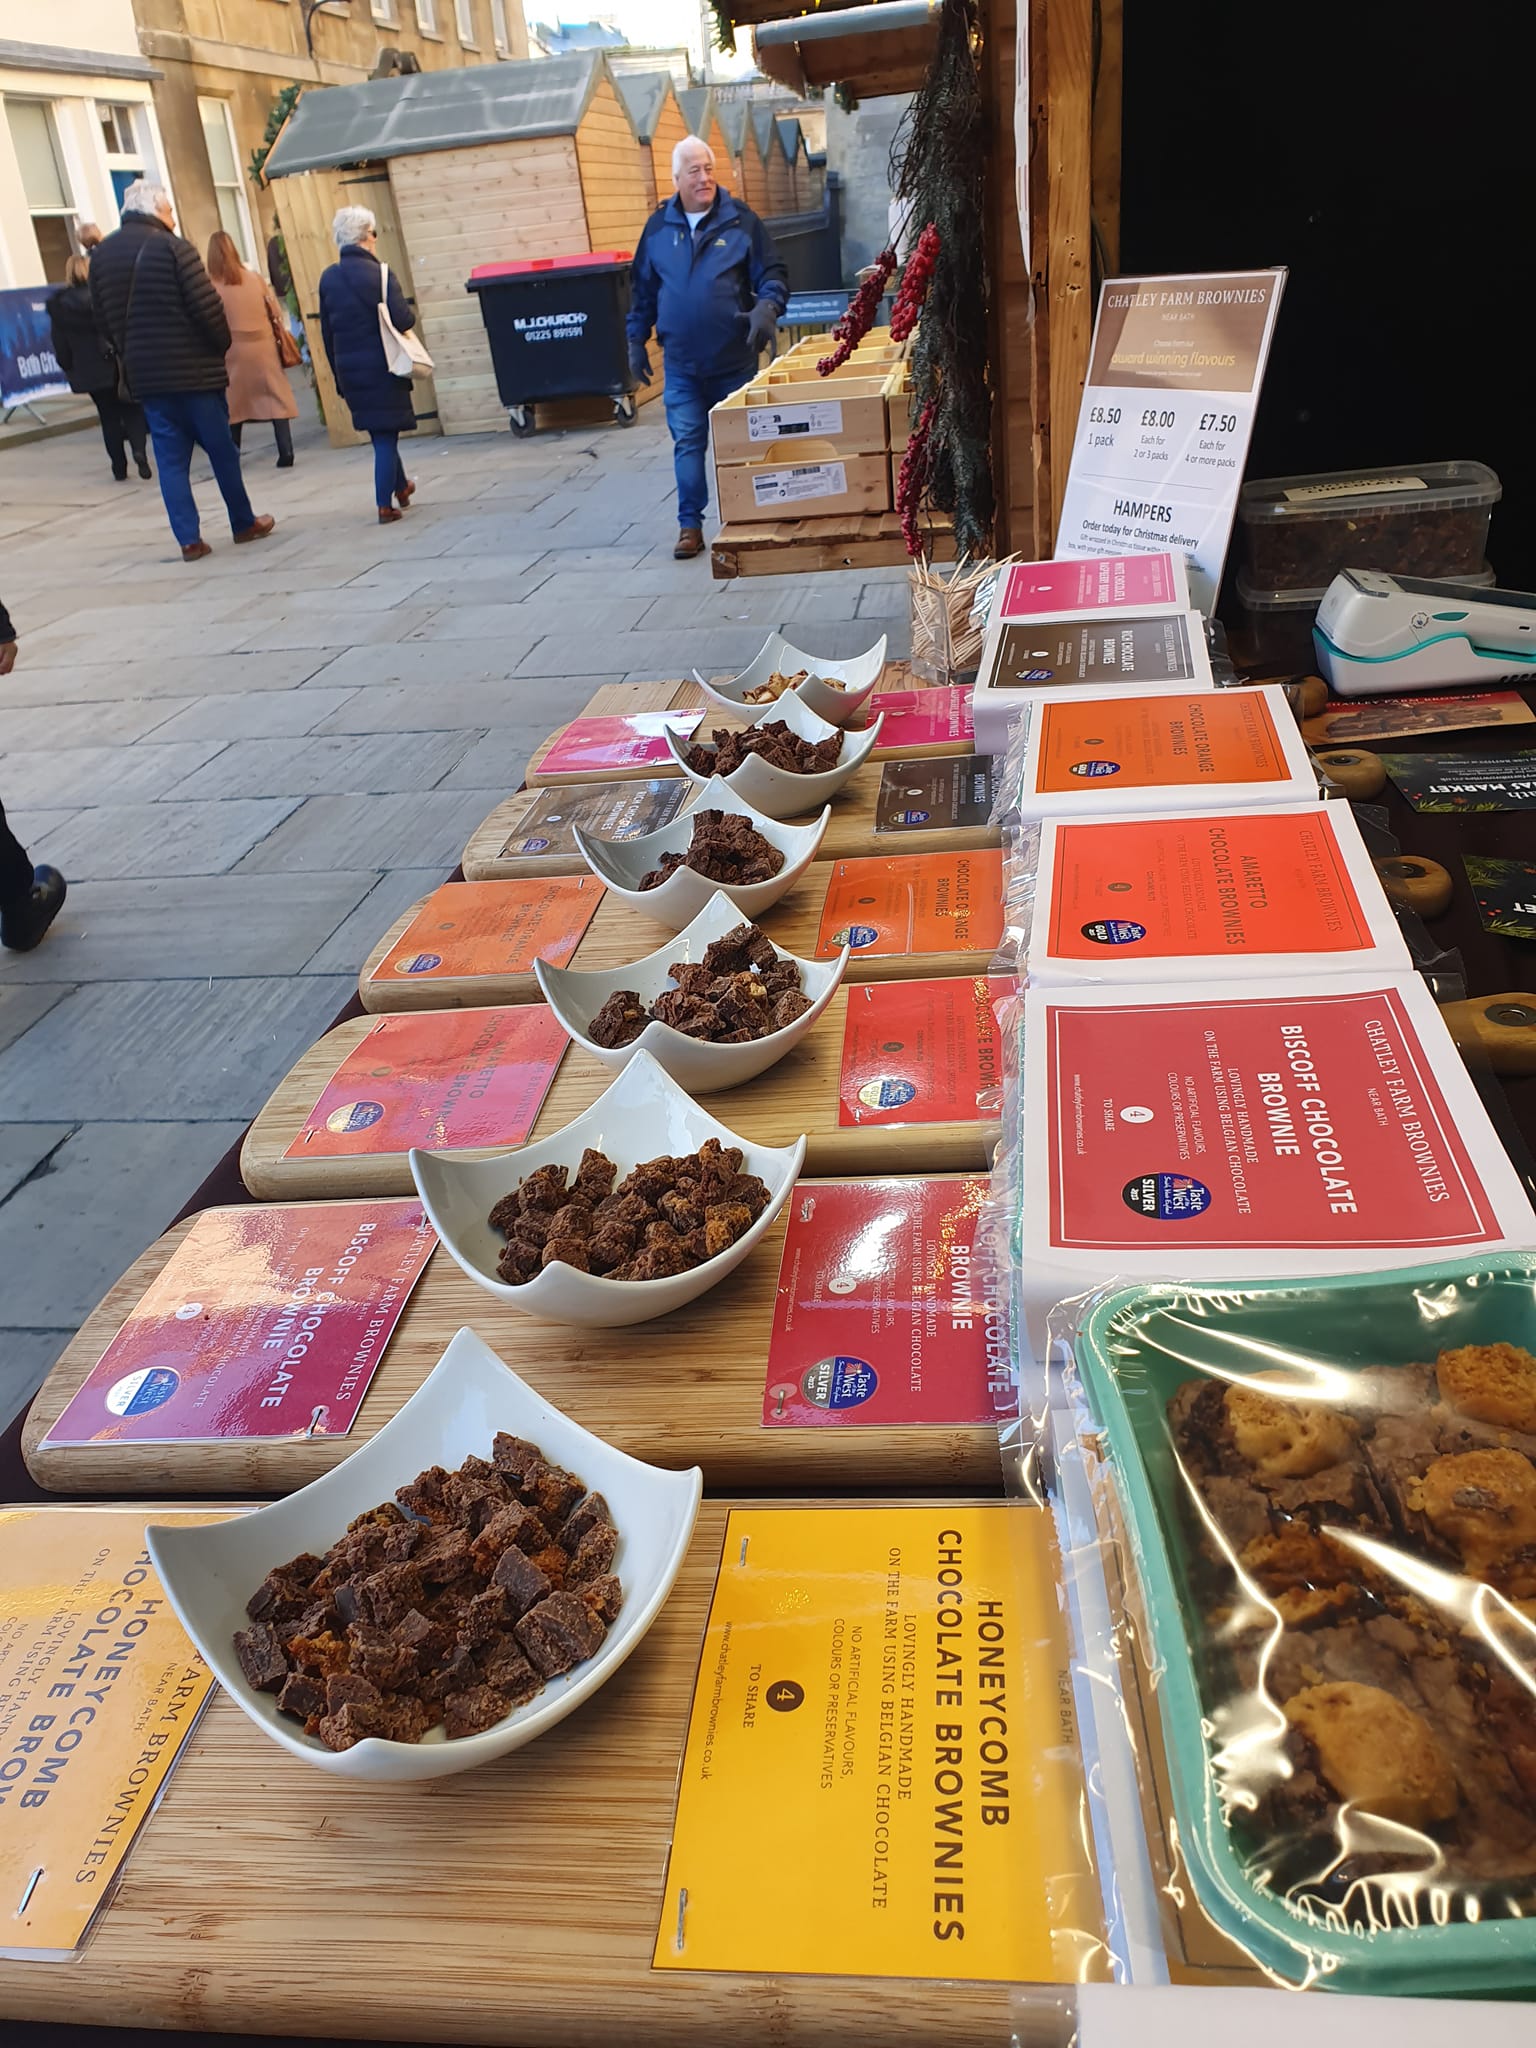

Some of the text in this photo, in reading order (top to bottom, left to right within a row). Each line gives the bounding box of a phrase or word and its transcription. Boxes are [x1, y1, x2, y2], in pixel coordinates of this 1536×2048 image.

[1107, 288, 1266, 309] CHATLEY FARM BROWNIES
[1111, 351, 1236, 368] award winning flavours
[1089, 407, 1122, 424] £8.50
[1141, 410, 1175, 428] £8.00
[1199, 413, 1237, 433] £7.50
[1088, 433, 1115, 447] 1 pack
[1141, 435, 1166, 446] Each for
[1199, 440, 1226, 451] Each for
[1113, 499, 1172, 523] HAMPERS
[1082, 519, 1199, 550] Order today for Christmas delivery
[1103, 638, 1116, 664] BROWNIES
[1121, 630, 1135, 672] RICH CHOCOLATE
[1168, 721, 1188, 755] BROWNIES
[1187, 703, 1215, 772] CHOCOLATE ORANGE
[974, 773, 986, 803] BROWNIES
[1429, 784, 1507, 793] MARKET
[935, 878, 951, 917] BROWNIES
[956, 859, 971, 901] CHOCOLATE
[1209, 827, 1245, 944] CHOCOLATE BROWNIES
[1240, 855, 1268, 909] AMARETTO
[1299, 830, 1344, 931] CHATLEY FARM BROWNIES
[500, 903, 534, 942] BROWNIES
[527, 885, 562, 927] CHOCOLATE
[506, 928, 536, 964] ORANGE
[1095, 924, 1108, 940] GOLD
[976, 985, 993, 1043] OCOLATE
[426, 1014, 506, 1139] CHOCOLATE BROWNS
[467, 1040, 506, 1099] AMARETTO
[1103, 1099, 1115, 1131] TO SHARE
[1167, 1072, 1190, 1160] COLOURS OR PRESERVATIVES
[1184, 1076, 1206, 1155] NO ARTIFICIAL FLAVOURS,
[1203, 1030, 1251, 1214] ON THE FARM USING BELGIAN CHOCOLATE
[1227, 1067, 1259, 1164] LOVINGLY HANDMADE
[1257, 1072, 1300, 1156] BROWNIE
[1280, 1025, 1358, 1214] BISCOFF CHOCOLATE
[1364, 1019, 1450, 1204] CHATLEY FARM BROWNIES
[1366, 1087, 1390, 1128] NEAR BATH
[1142, 1178, 1156, 1211] SILVER
[1173, 1187, 1187, 1210] West
[1190, 1187, 1205, 1211] Taste
[328, 1223, 377, 1285] BISCOFF
[913, 1233, 922, 1255] FARM
[912, 1256, 922, 1282] USING
[926, 1239, 937, 1338] LOVINGLY HANDMADE
[951, 1244, 973, 1330] BROWNIE
[262, 1268, 325, 1350] BROWNIE
[336, 1223, 434, 1400] CHATLEY FARM BROWNIES
[885, 1292, 897, 1328] FLAVOURS,
[911, 1285, 922, 1325] BELGIAN
[260, 1291, 336, 1408] CHOCOLATE
[983, 1274, 1010, 1394] CHOCOLATE
[911, 1329, 922, 1392] CHOCOLATE
[115, 1375, 142, 1407] SILVER
[151, 1381, 175, 1404] Taste
[815, 1364, 830, 1400] SILVER
[842, 1373, 853, 1397] West
[857, 1372, 871, 1398] Taste
[19, 1600, 164, 1809] HONEYCOMB
[134, 1663, 178, 1731] NEAR BATH
[700, 1621, 736, 1780] www.chatleyfarmbrownies.co.uk
[743, 1664, 762, 1729] TO SHARE
[776, 1687, 796, 1701] 4
[820, 1618, 846, 1790] COLOURS OR PRESERVATIVES
[840, 1625, 863, 1779] NO ARTIFICIAL FLAVOURS,
[897, 1614, 916, 1800] LOVINGLY HANDMADE
[978, 1600, 1011, 1826] HONEYCOMB
[1057, 1669, 1075, 1744] NEAR BATH
[872, 1547, 901, 1909] ON THE FARM USING BELGIAN CHOCOLATE
[933, 1529, 965, 1942] CHOCOLATE BROWNIES
[75, 1653, 207, 1885] FARM BROWNIES
